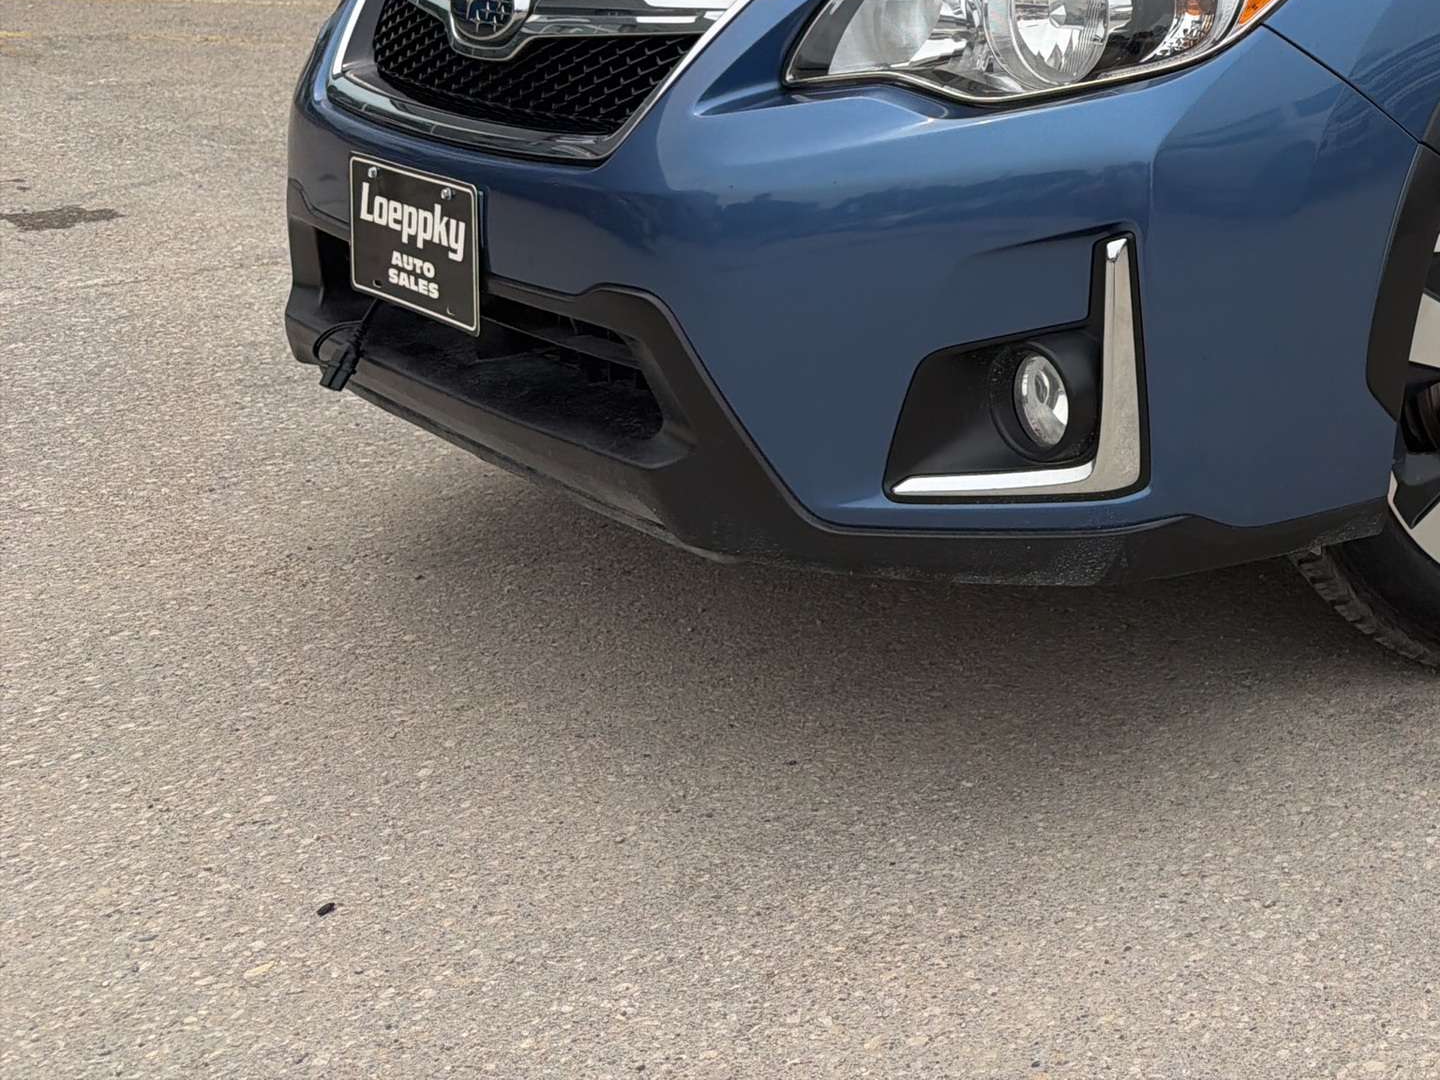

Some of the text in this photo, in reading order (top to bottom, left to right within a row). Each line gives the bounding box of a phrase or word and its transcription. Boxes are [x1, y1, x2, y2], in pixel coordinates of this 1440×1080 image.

[360, 181, 466, 262] Loeppky
[391, 250, 435, 279] AUTO
[388, 268, 439, 300] SALES
